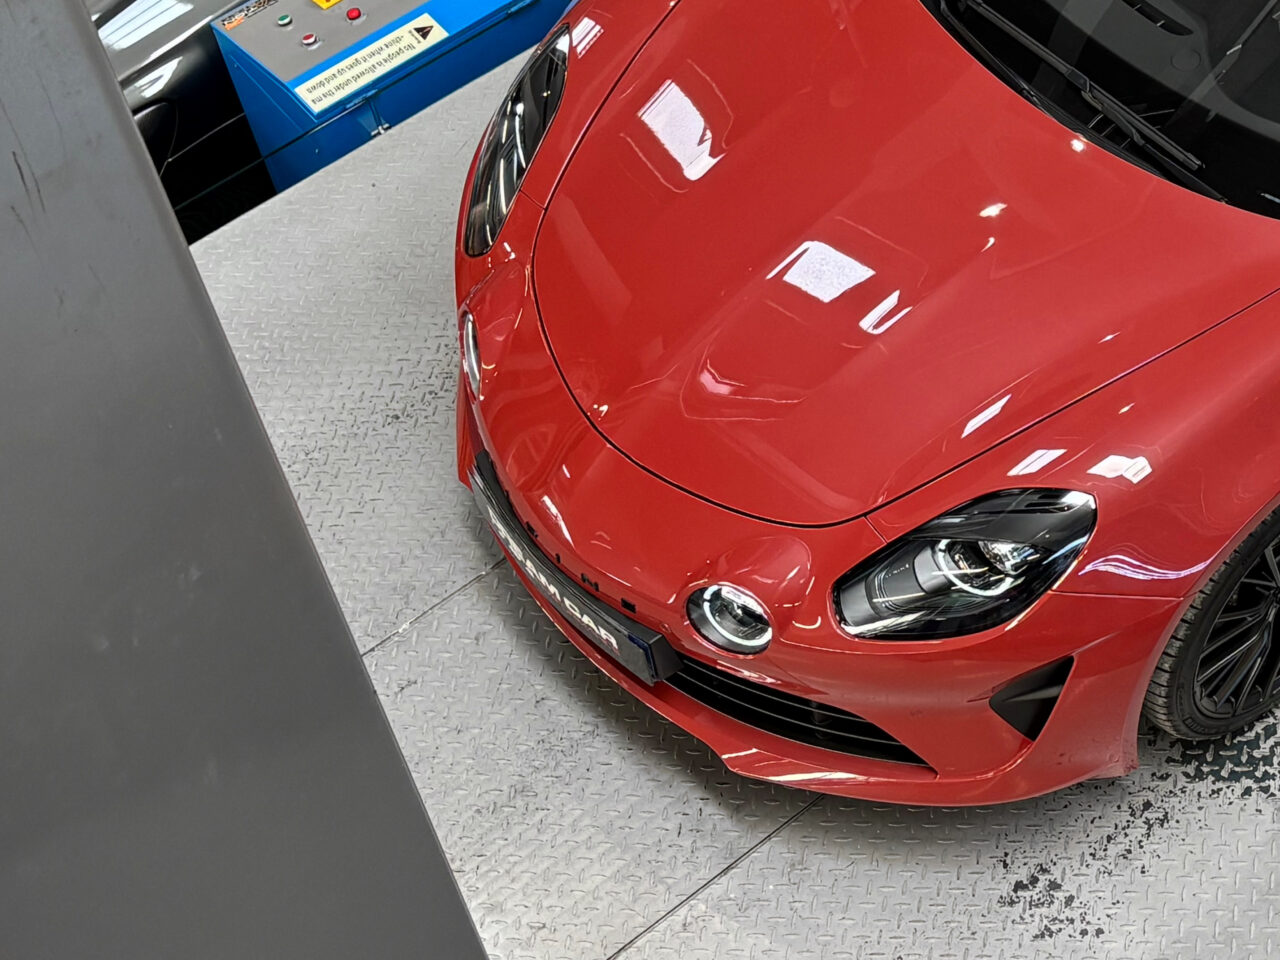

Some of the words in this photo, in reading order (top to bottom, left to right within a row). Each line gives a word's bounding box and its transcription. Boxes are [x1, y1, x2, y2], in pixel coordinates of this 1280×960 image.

[366, 46, 384, 58] when
[382, 47, 405, 63] people
[345, 58, 362, 70] goes
[324, 73, 338, 84] and
[337, 68, 347, 76] up
[351, 63, 377, 83] allowed
[306, 80, 326, 93] down
[333, 78, 353, 91] under
[563, 596, 619, 650] CAR
